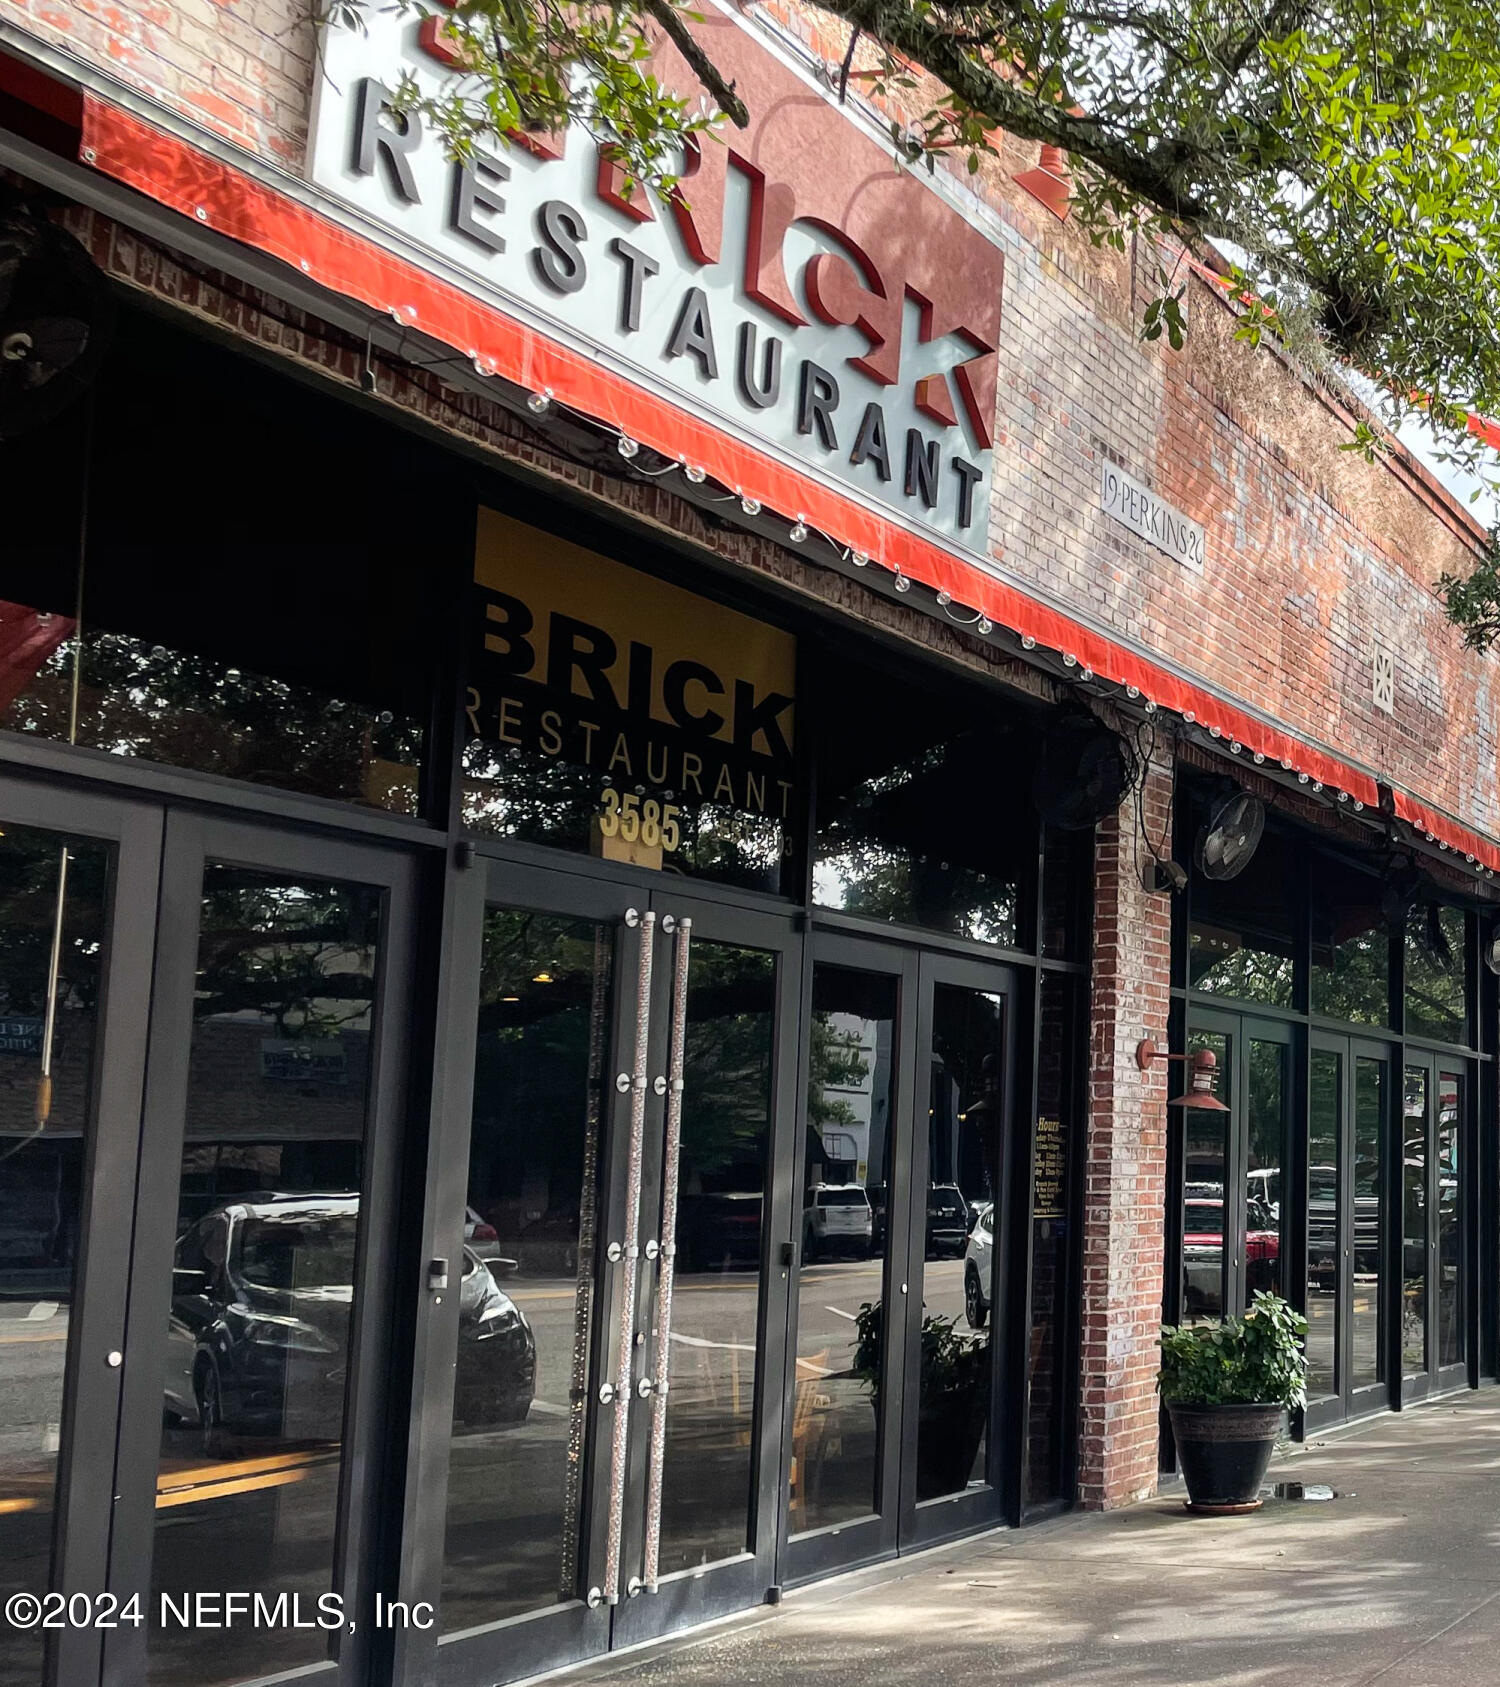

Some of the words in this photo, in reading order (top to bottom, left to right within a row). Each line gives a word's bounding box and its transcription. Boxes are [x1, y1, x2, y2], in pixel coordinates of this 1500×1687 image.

[351, 76, 983, 529] RESTAURANT
[471, 584, 795, 758] BRICK
[465, 686, 794, 818] RESTAURANT
[600, 787, 681, 852] 3585
[1037, 1116, 1060, 1132] Hours
